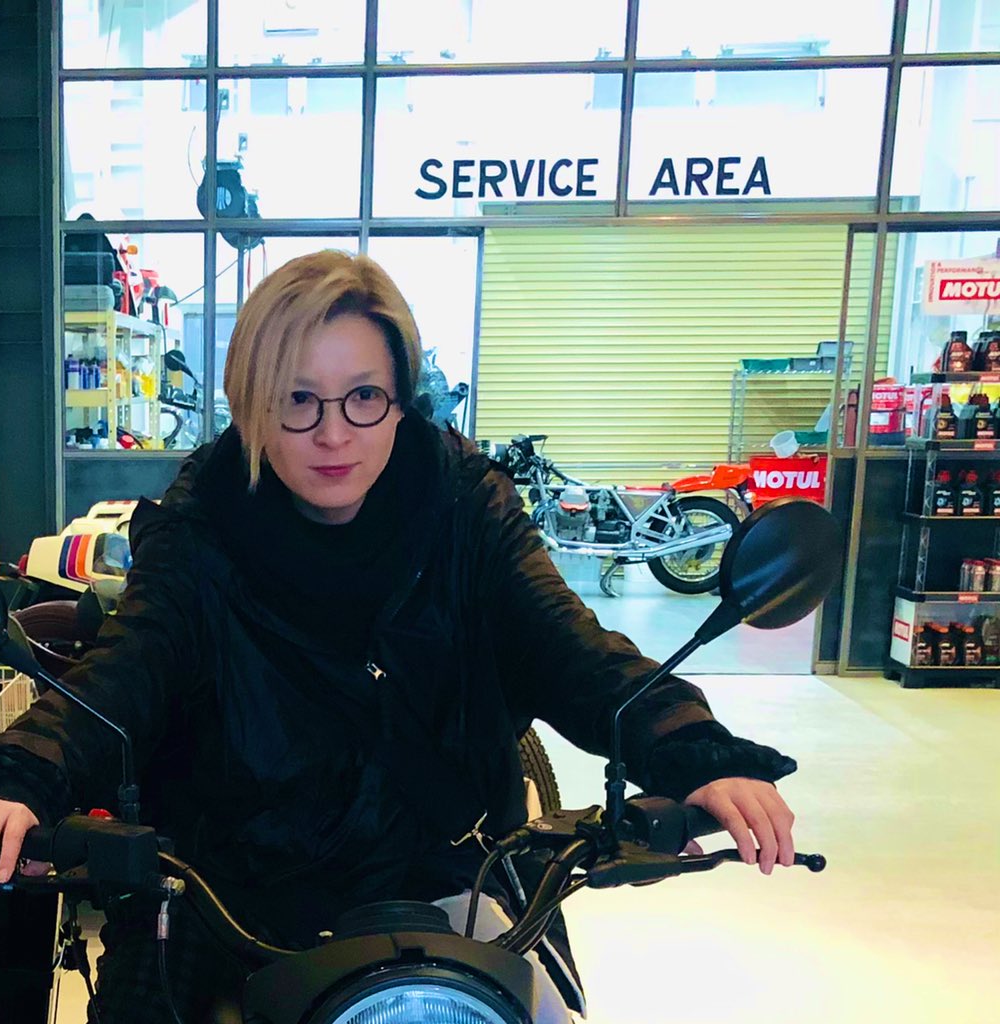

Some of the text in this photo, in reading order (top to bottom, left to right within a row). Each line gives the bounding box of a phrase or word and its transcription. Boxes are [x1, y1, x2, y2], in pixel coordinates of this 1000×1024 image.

[414, 156, 772, 200] SERVICE AREA
[753, 470, 821, 489] MOTUL
